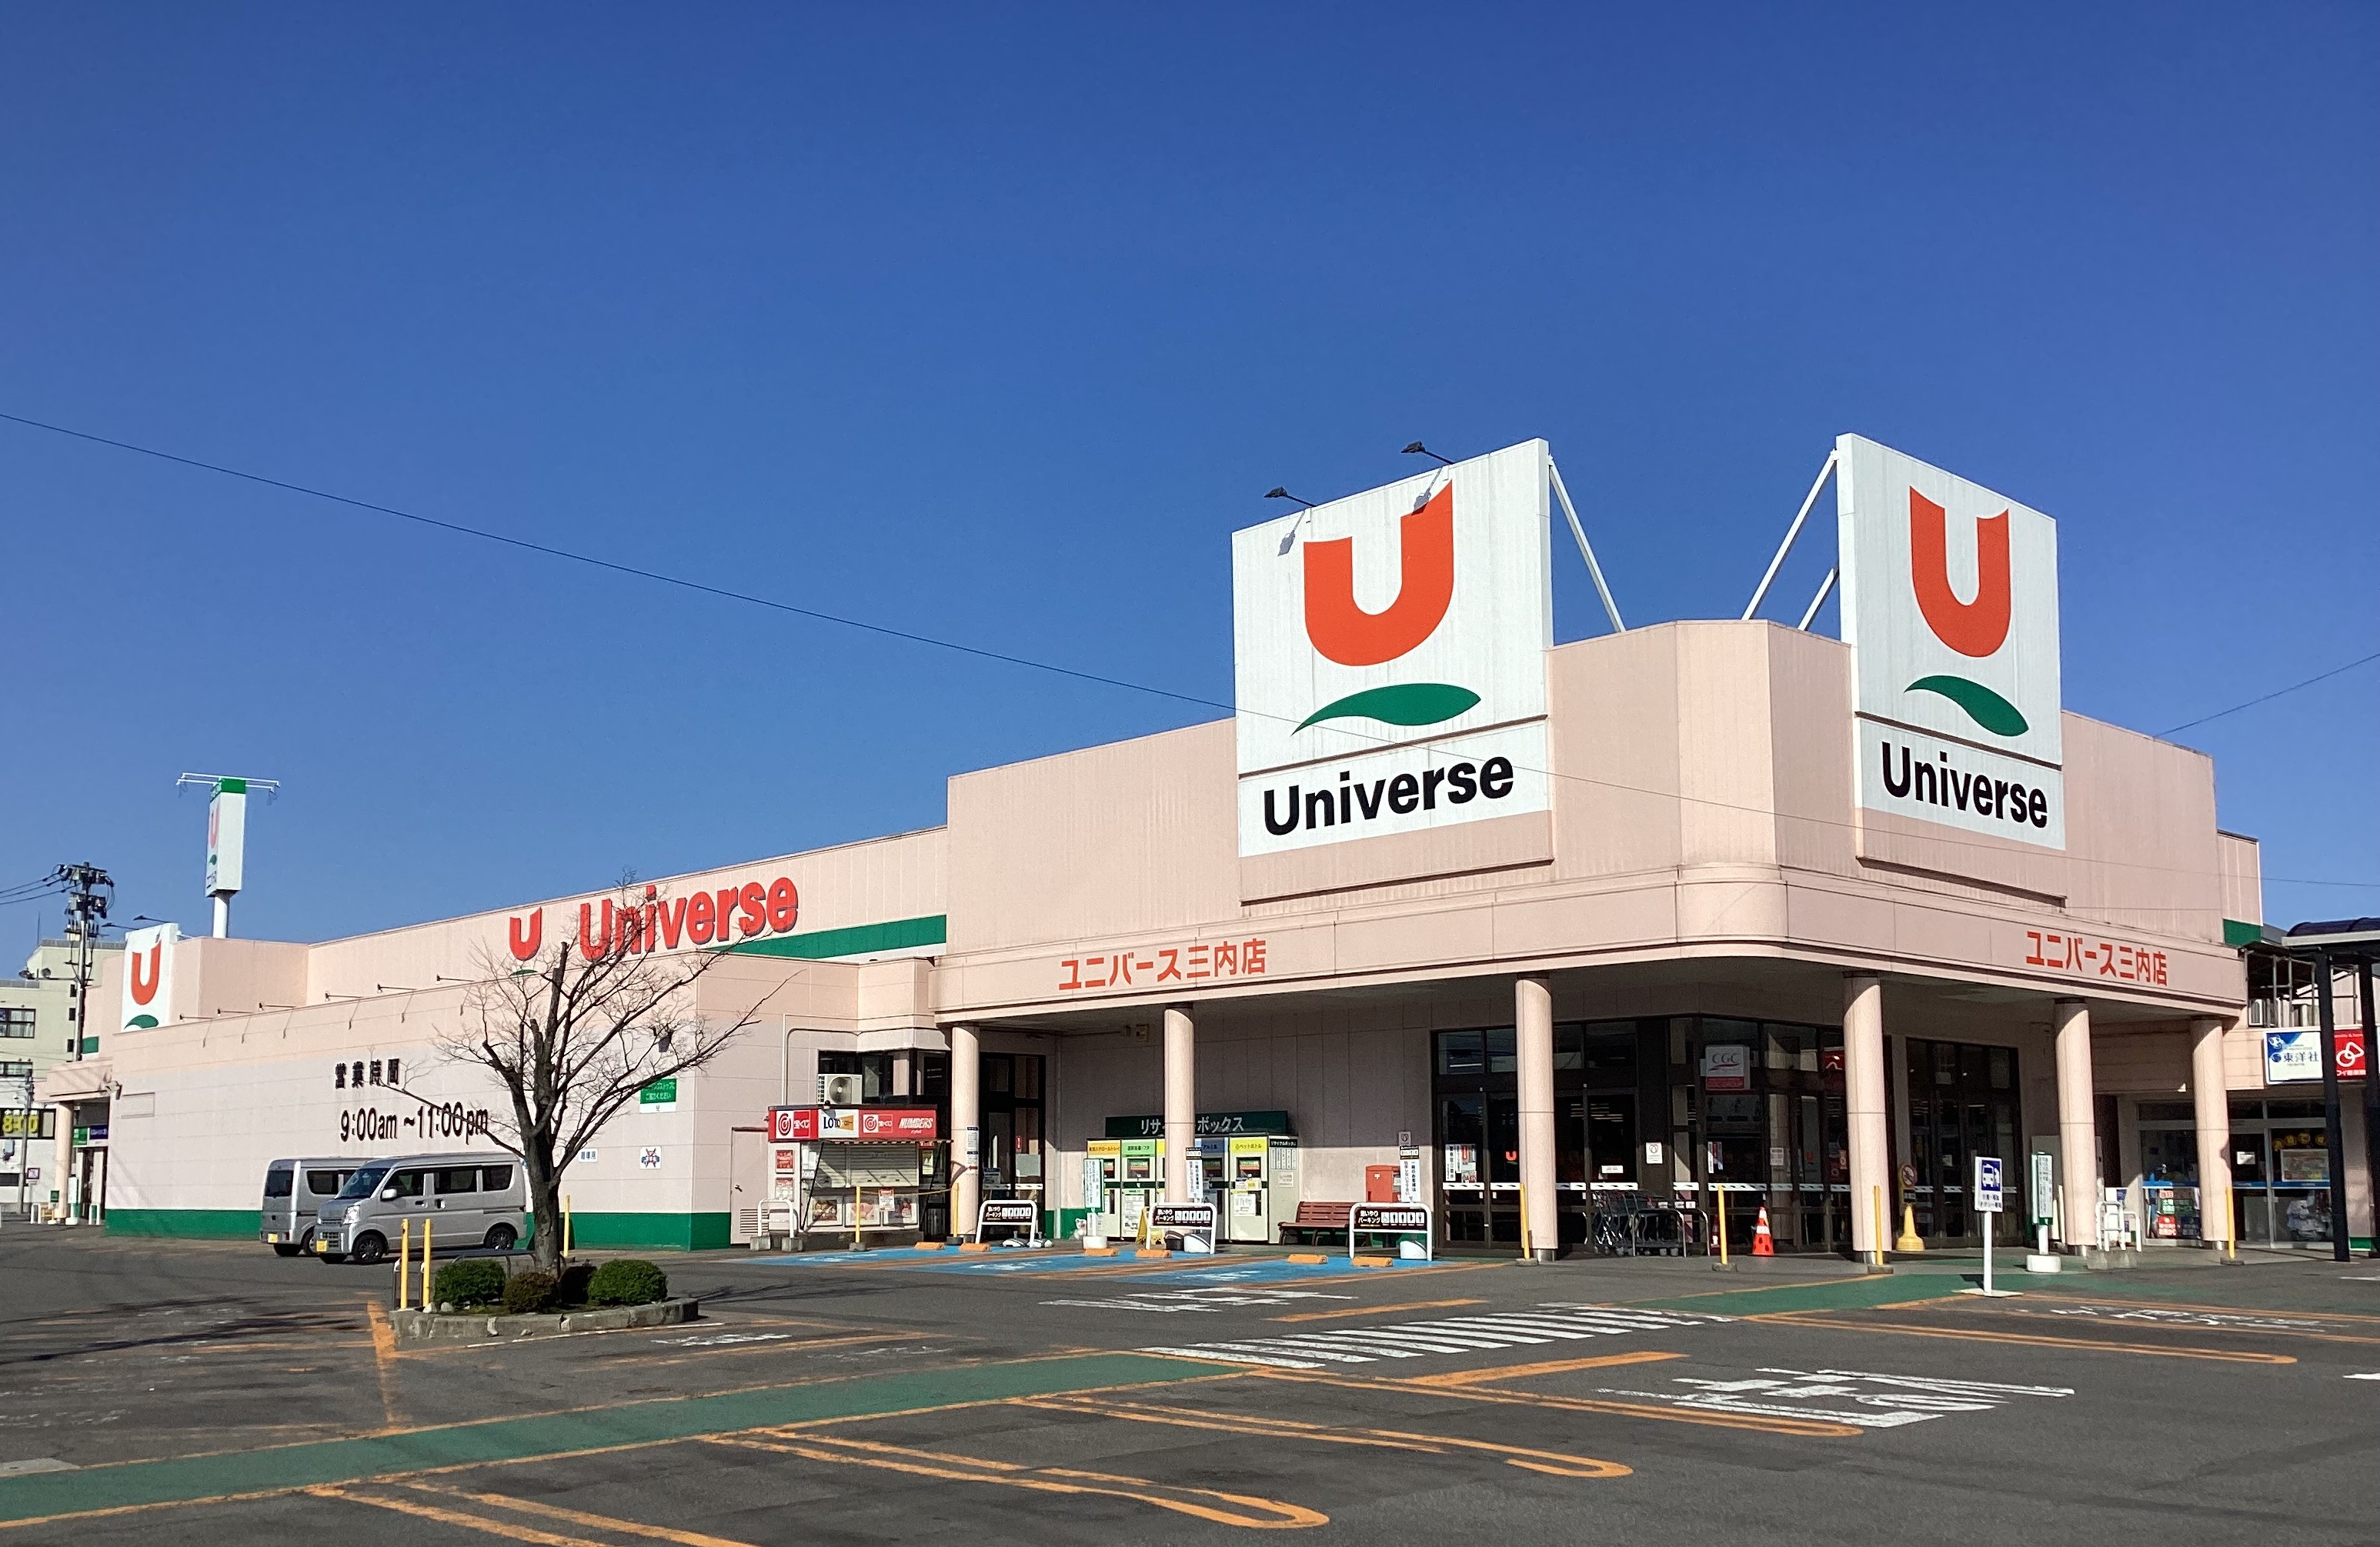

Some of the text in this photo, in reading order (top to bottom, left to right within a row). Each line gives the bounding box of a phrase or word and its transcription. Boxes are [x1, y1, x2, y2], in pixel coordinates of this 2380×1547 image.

[1303, 480, 1454, 666] U
[1910, 486, 2011, 658] U
[1263, 755, 1514, 836] Universe
[1881, 741, 2048, 829] Universe
[579, 876, 799, 962] Universe
[1058, 938, 1267, 991] ユニバース三内店
[2025, 931, 2168, 987] ユニバース三内店
[335, 1058, 399, 1089] 営業時間
[1711, 1052, 1741, 1065] CGC
[898, 1117, 934, 1129] NUMBERS
[1141, 1116, 1244, 1134] リサボックス
